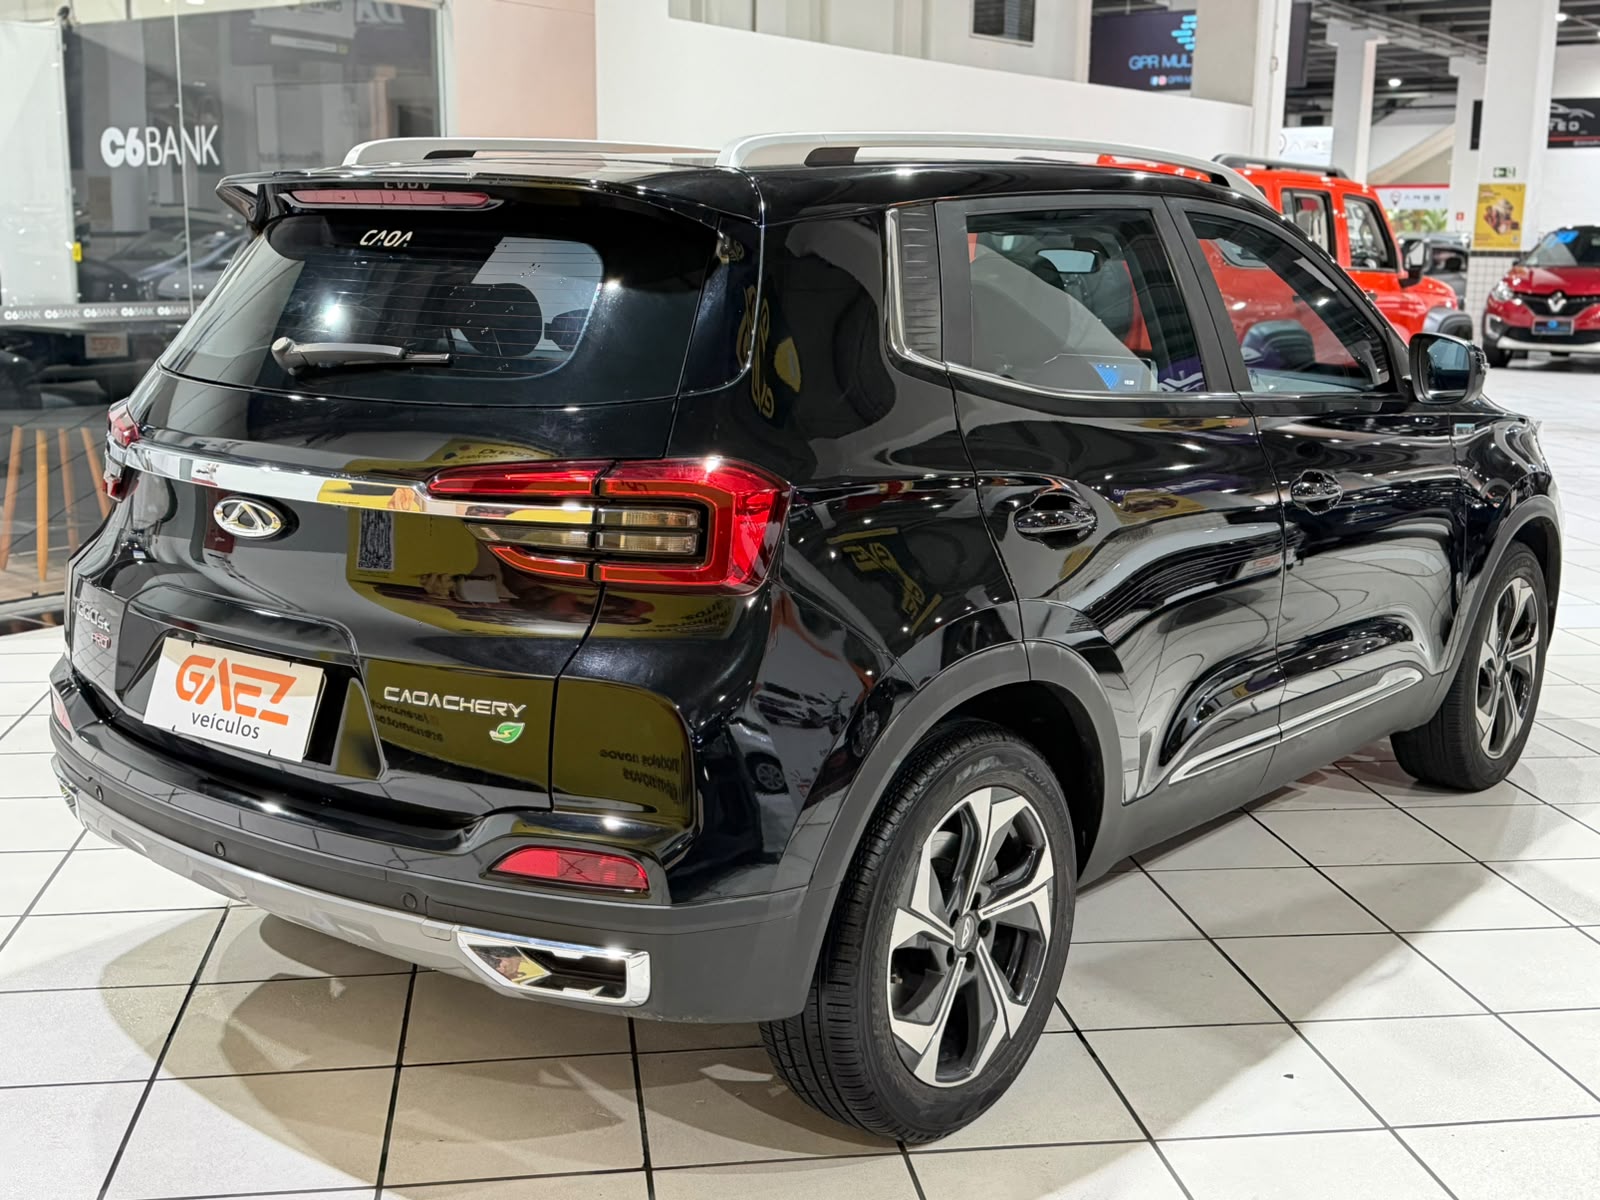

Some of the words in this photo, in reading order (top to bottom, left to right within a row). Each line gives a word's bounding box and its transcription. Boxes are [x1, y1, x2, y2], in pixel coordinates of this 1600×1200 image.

[1128, 54, 1160, 71] GPR
[359, 229, 413, 248] CAOA
[191, 712, 260, 740] veículos
